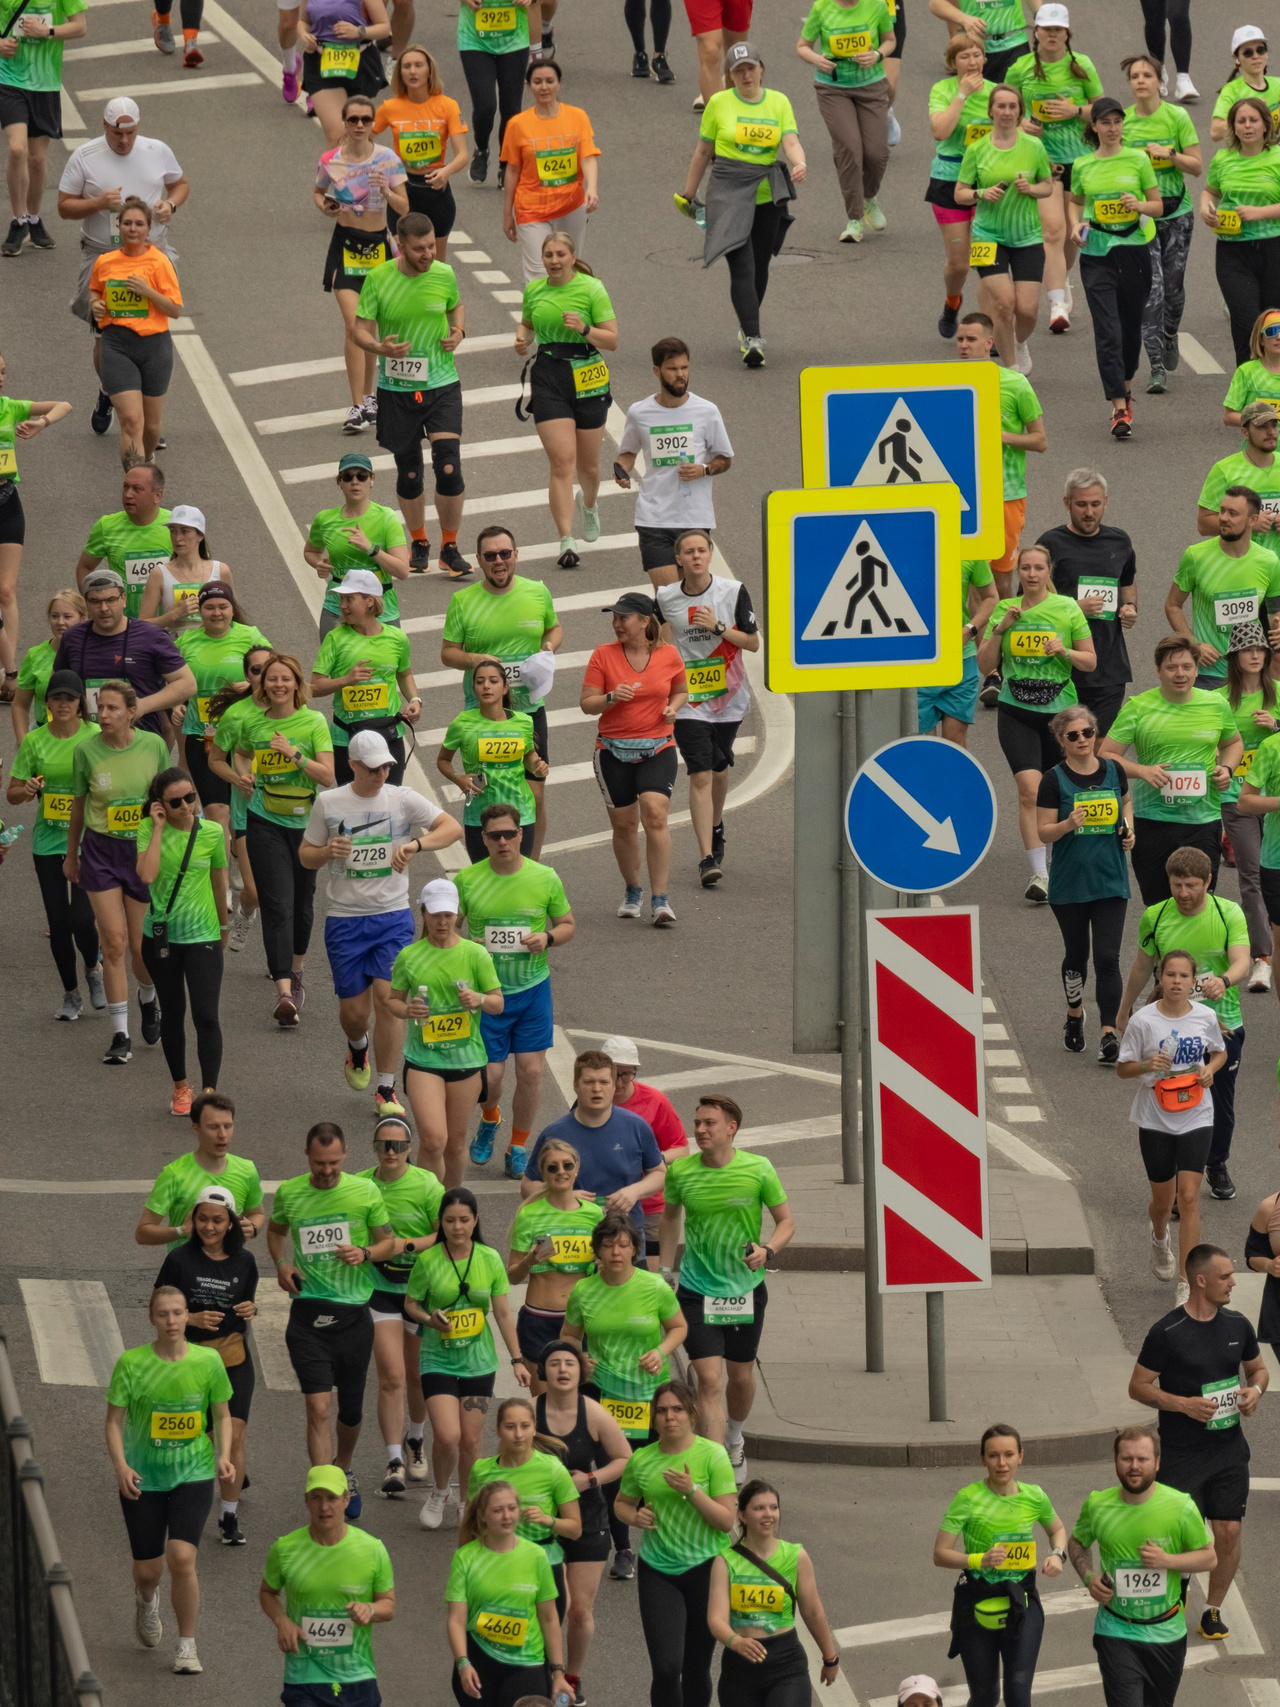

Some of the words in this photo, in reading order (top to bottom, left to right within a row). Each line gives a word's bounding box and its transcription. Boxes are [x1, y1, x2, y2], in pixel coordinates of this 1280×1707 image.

[481, 11, 510, 23] 3925
[836, 36, 865, 49] 5750
[327, 49, 355, 62] 1899
[743, 126, 773, 139] 1652
[406, 139, 435, 153] 6201
[543, 158, 572, 172] 6241
[112, 291, 142, 303] 3478
[391, 359, 422, 373] 2179
[580, 365, 606, 384] 2230
[656, 437, 688, 450] 3902
[131, 561, 163, 576] 468
[1222, 601, 1254, 616] 3098
[688, 634, 711, 643] лапы
[1017, 636, 1049, 648] 4199
[690, 669, 721, 685] 6240
[349, 688, 381, 703] 2257
[486, 742, 518, 754] 2727
[1169, 777, 1200, 791] 1076
[1083, 802, 1113, 817] 5375
[353, 847, 386, 862] 2728
[491, 931, 523, 944] 2351
[429, 1017, 462, 1033] 1429
[1159, 1036, 1203, 1049] ЮЗ
[307, 1227, 343, 1244] 2690
[608, 1404, 643, 1420] 3502
[159, 1416, 195, 1430] 2560
[1007, 1547, 1030, 1560] 404
[1124, 1573, 1160, 1588] 1962
[739, 1589, 776, 1604] 1416
[309, 1622, 346, 1637] 4649
[484, 1617, 521, 1636] 4660
